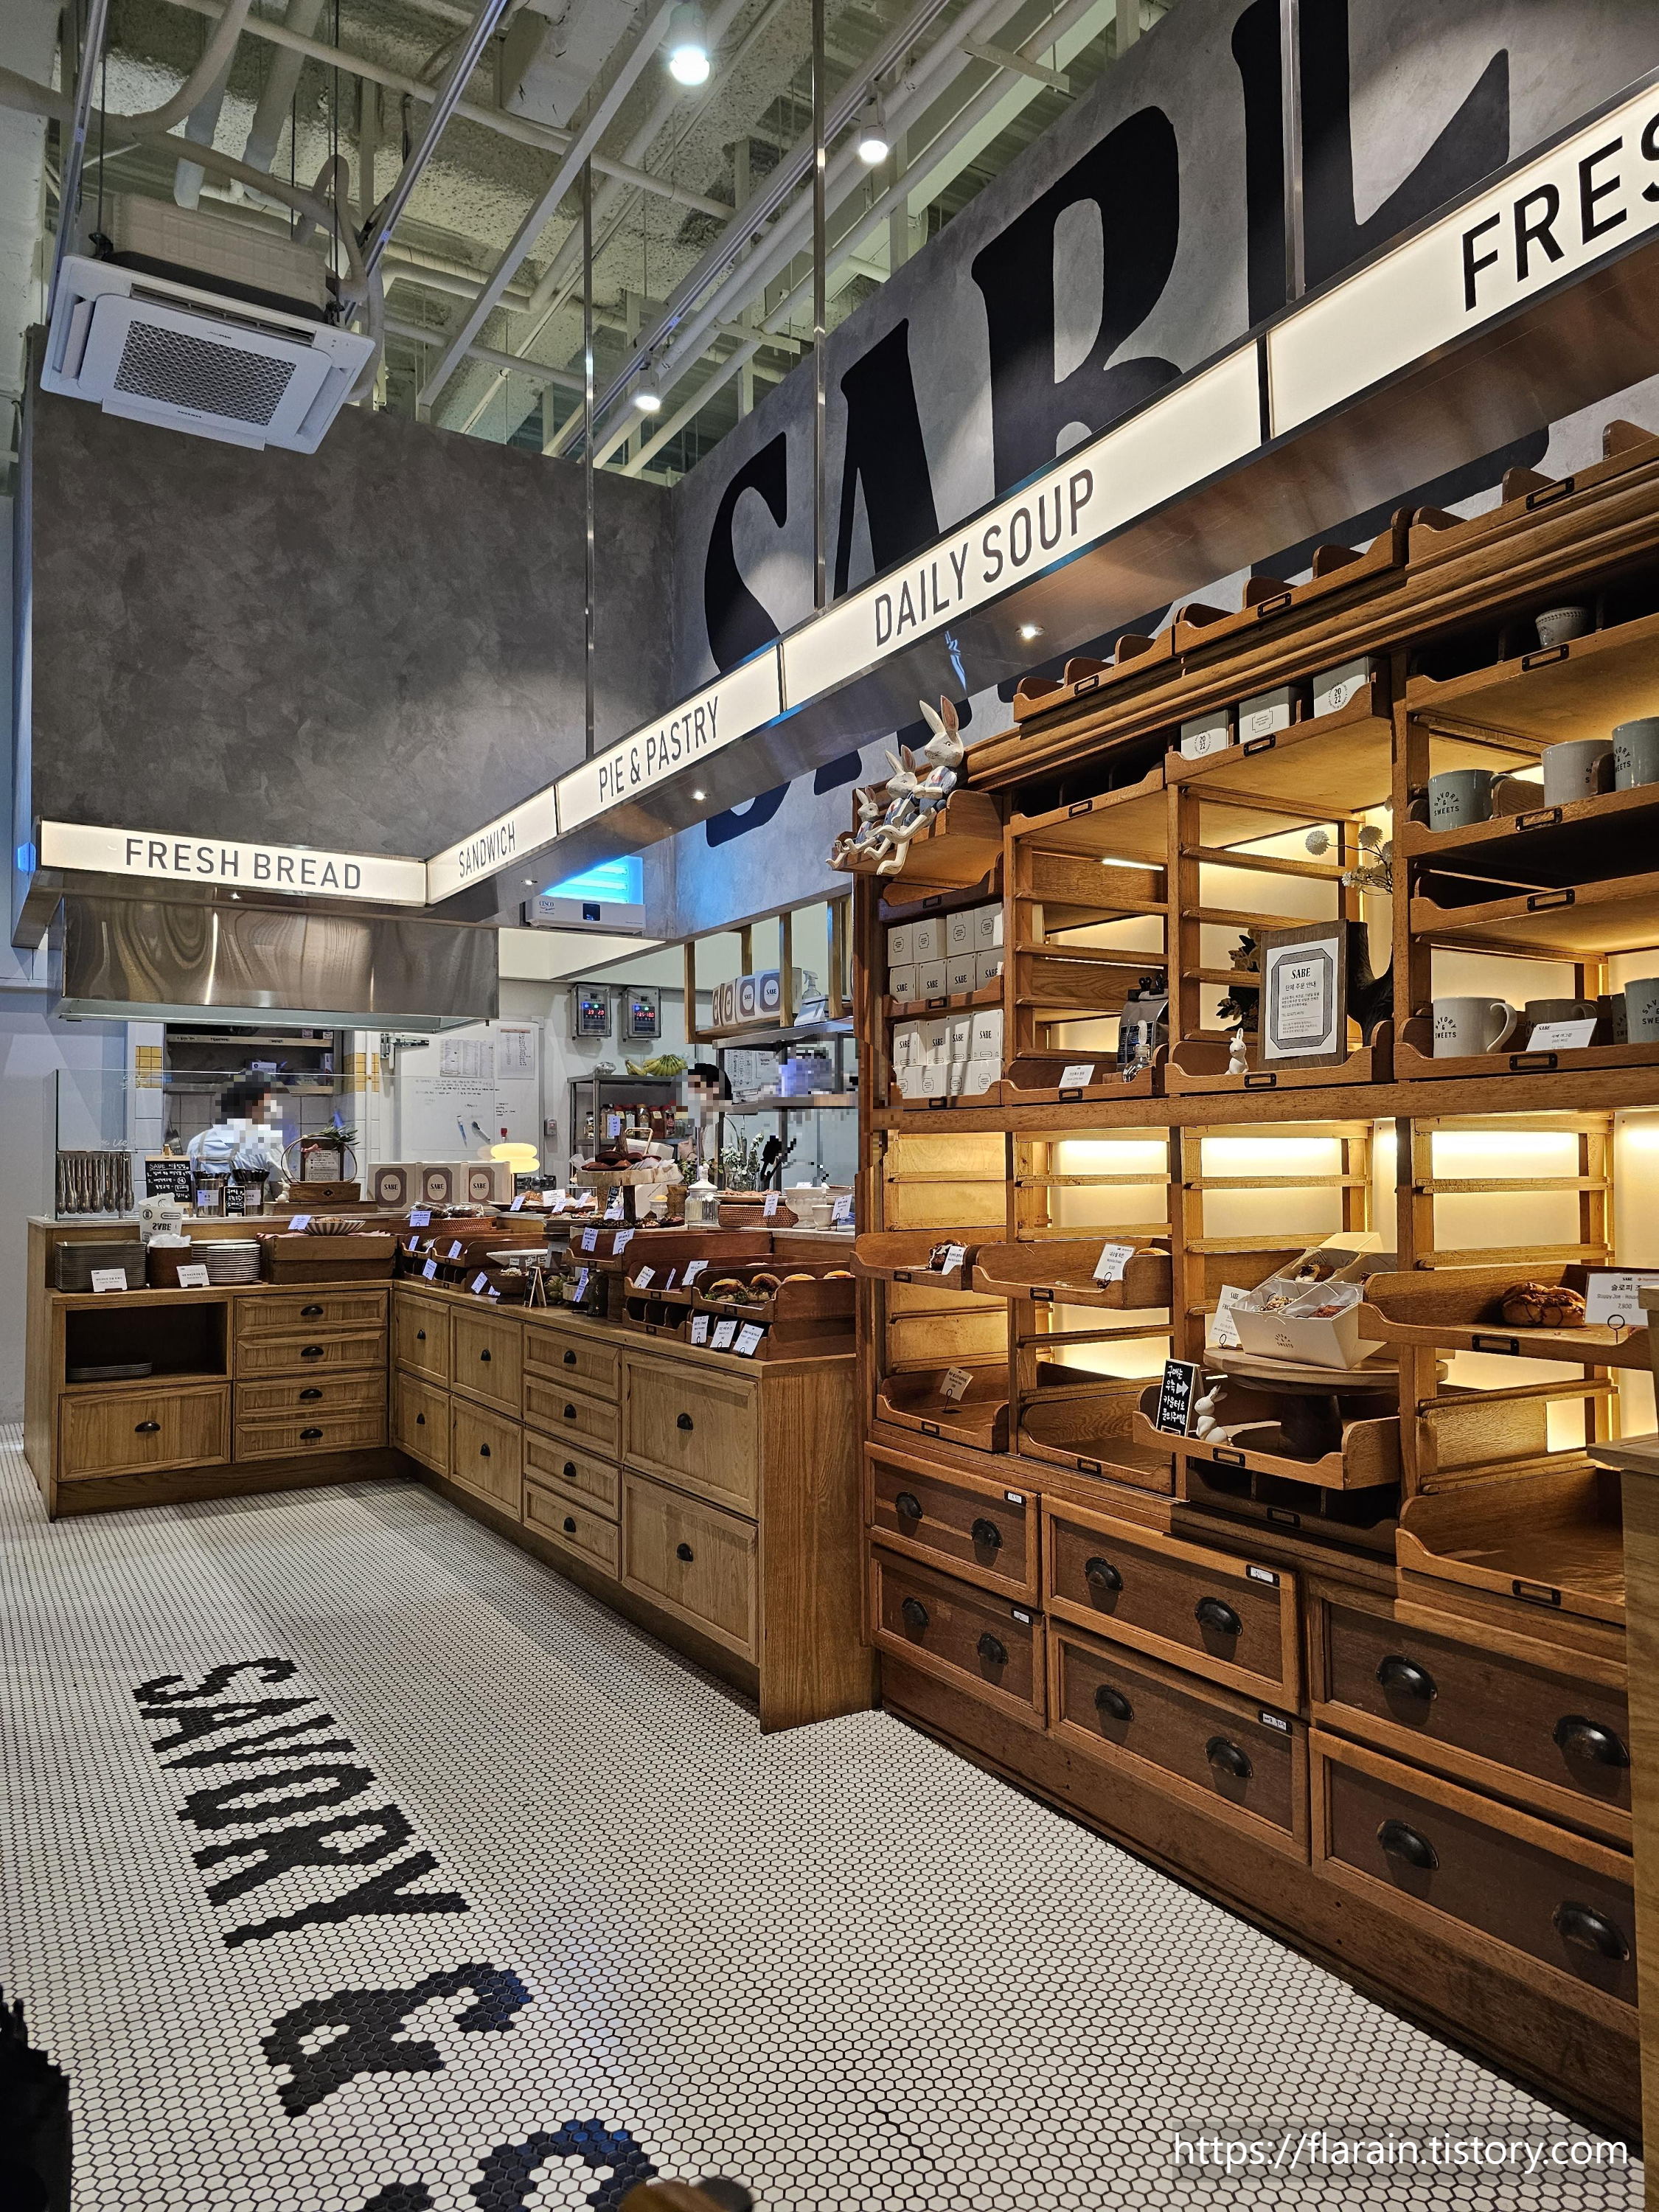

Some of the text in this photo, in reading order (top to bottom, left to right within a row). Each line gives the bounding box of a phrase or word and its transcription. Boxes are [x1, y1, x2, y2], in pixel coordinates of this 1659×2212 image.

[874, 469, 1093, 647] DAILY SOUP
[1335, 687, 1341, 696] 20
[1335, 695, 1341, 704] 22
[599, 696, 719, 802] PIE & PASTRY
[1200, 742, 1206, 751] 22
[1434, 791, 1459, 807] SAVORY
[1433, 805, 1460, 816] SWEETS
[459, 821, 515, 878] SANDWICH
[126, 838, 361, 889] FRESH BREAD
[1291, 967, 1311, 979] SABE
[926, 980, 938, 989] SABE
[955, 975, 967, 984] SABE
[896, 983, 908, 992] SABE
[952, 1034, 964, 1042] SABE
[979, 1030, 992, 1039] SABE
[900, 1040, 910, 1048] SABE
[932, 1037, 943, 1046] SABE
[1230, 1292, 1239, 1300] SABE
[1167, 1365, 1183, 1380] 구매는
[1165, 1379, 1175, 1394] 우측
[1163, 1395, 1186, 1411] 카운터로
[1161, 1408, 1186, 1425] 문의주세요
[131, 1656, 473, 1948] SAVORY
[258, 1961, 533, 2117] &
